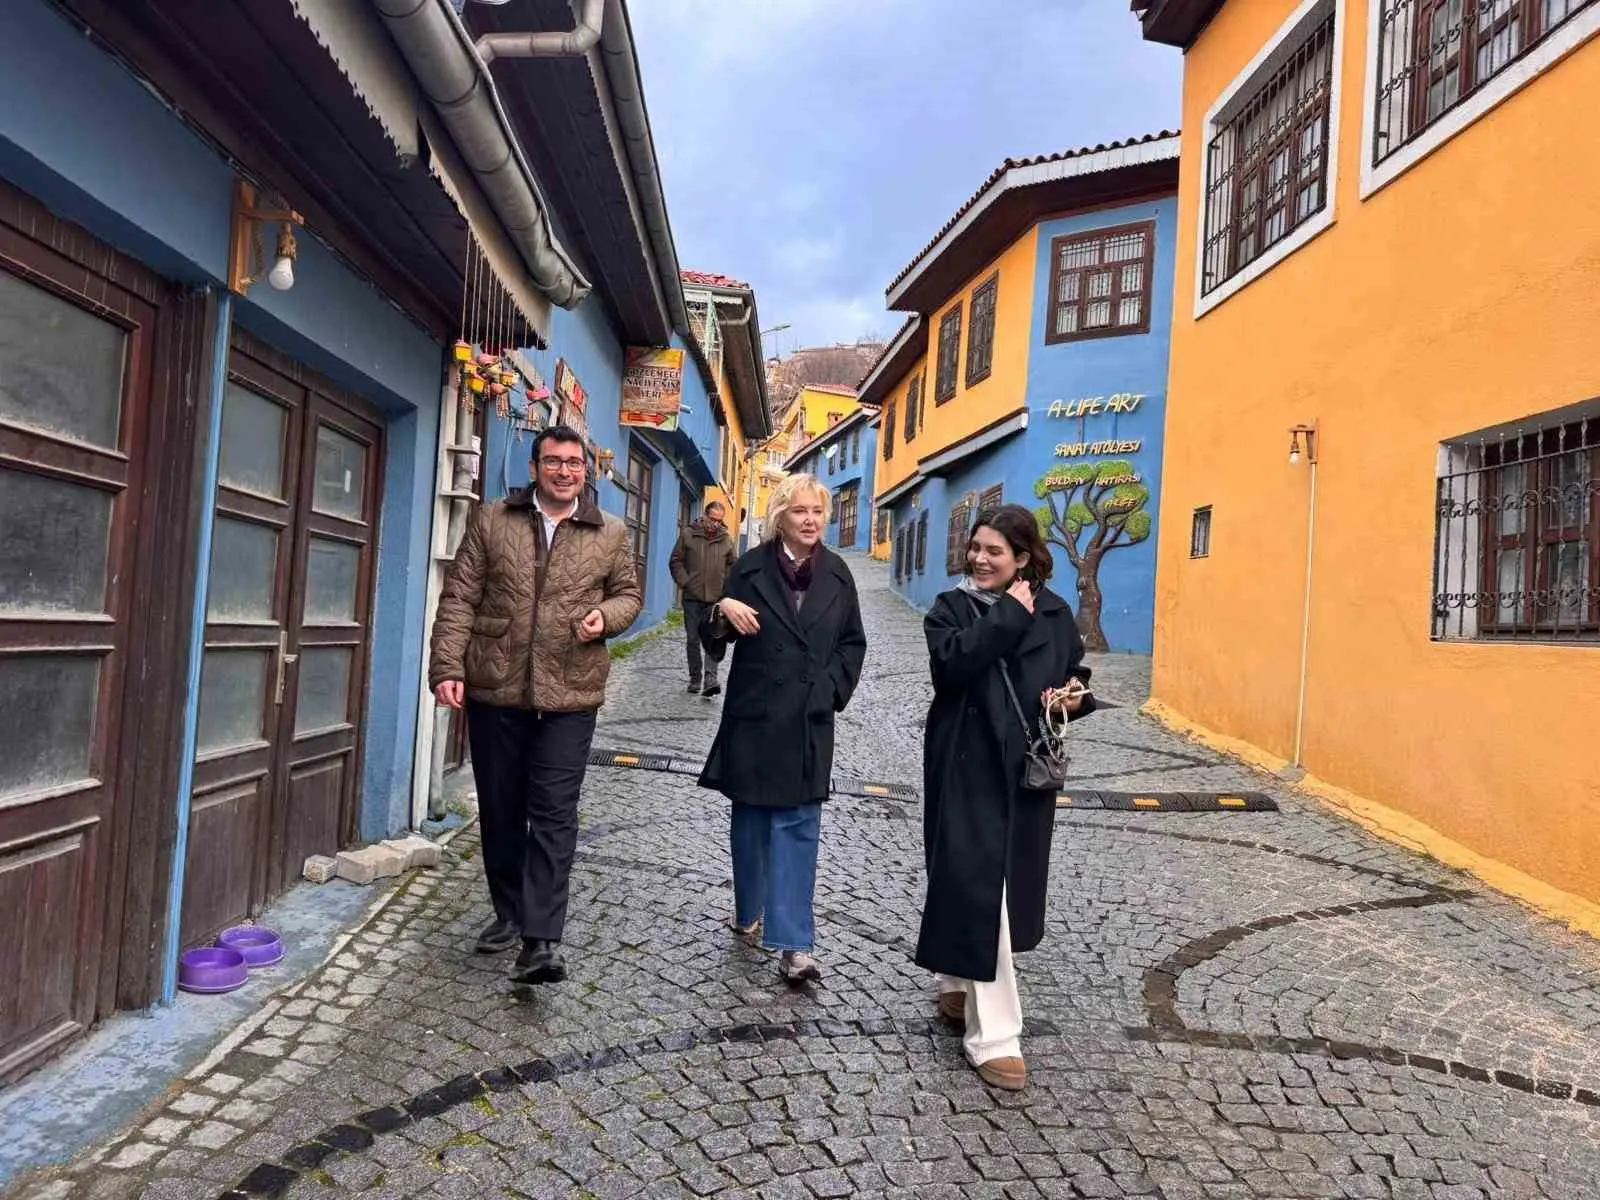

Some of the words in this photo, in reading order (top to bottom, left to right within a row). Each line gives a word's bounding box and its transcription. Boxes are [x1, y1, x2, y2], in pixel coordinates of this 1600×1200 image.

[1047, 397, 1103, 418] A-LIFE
[1104, 393, 1146, 413] ART
[1054, 442, 1088, 456] SANAT
